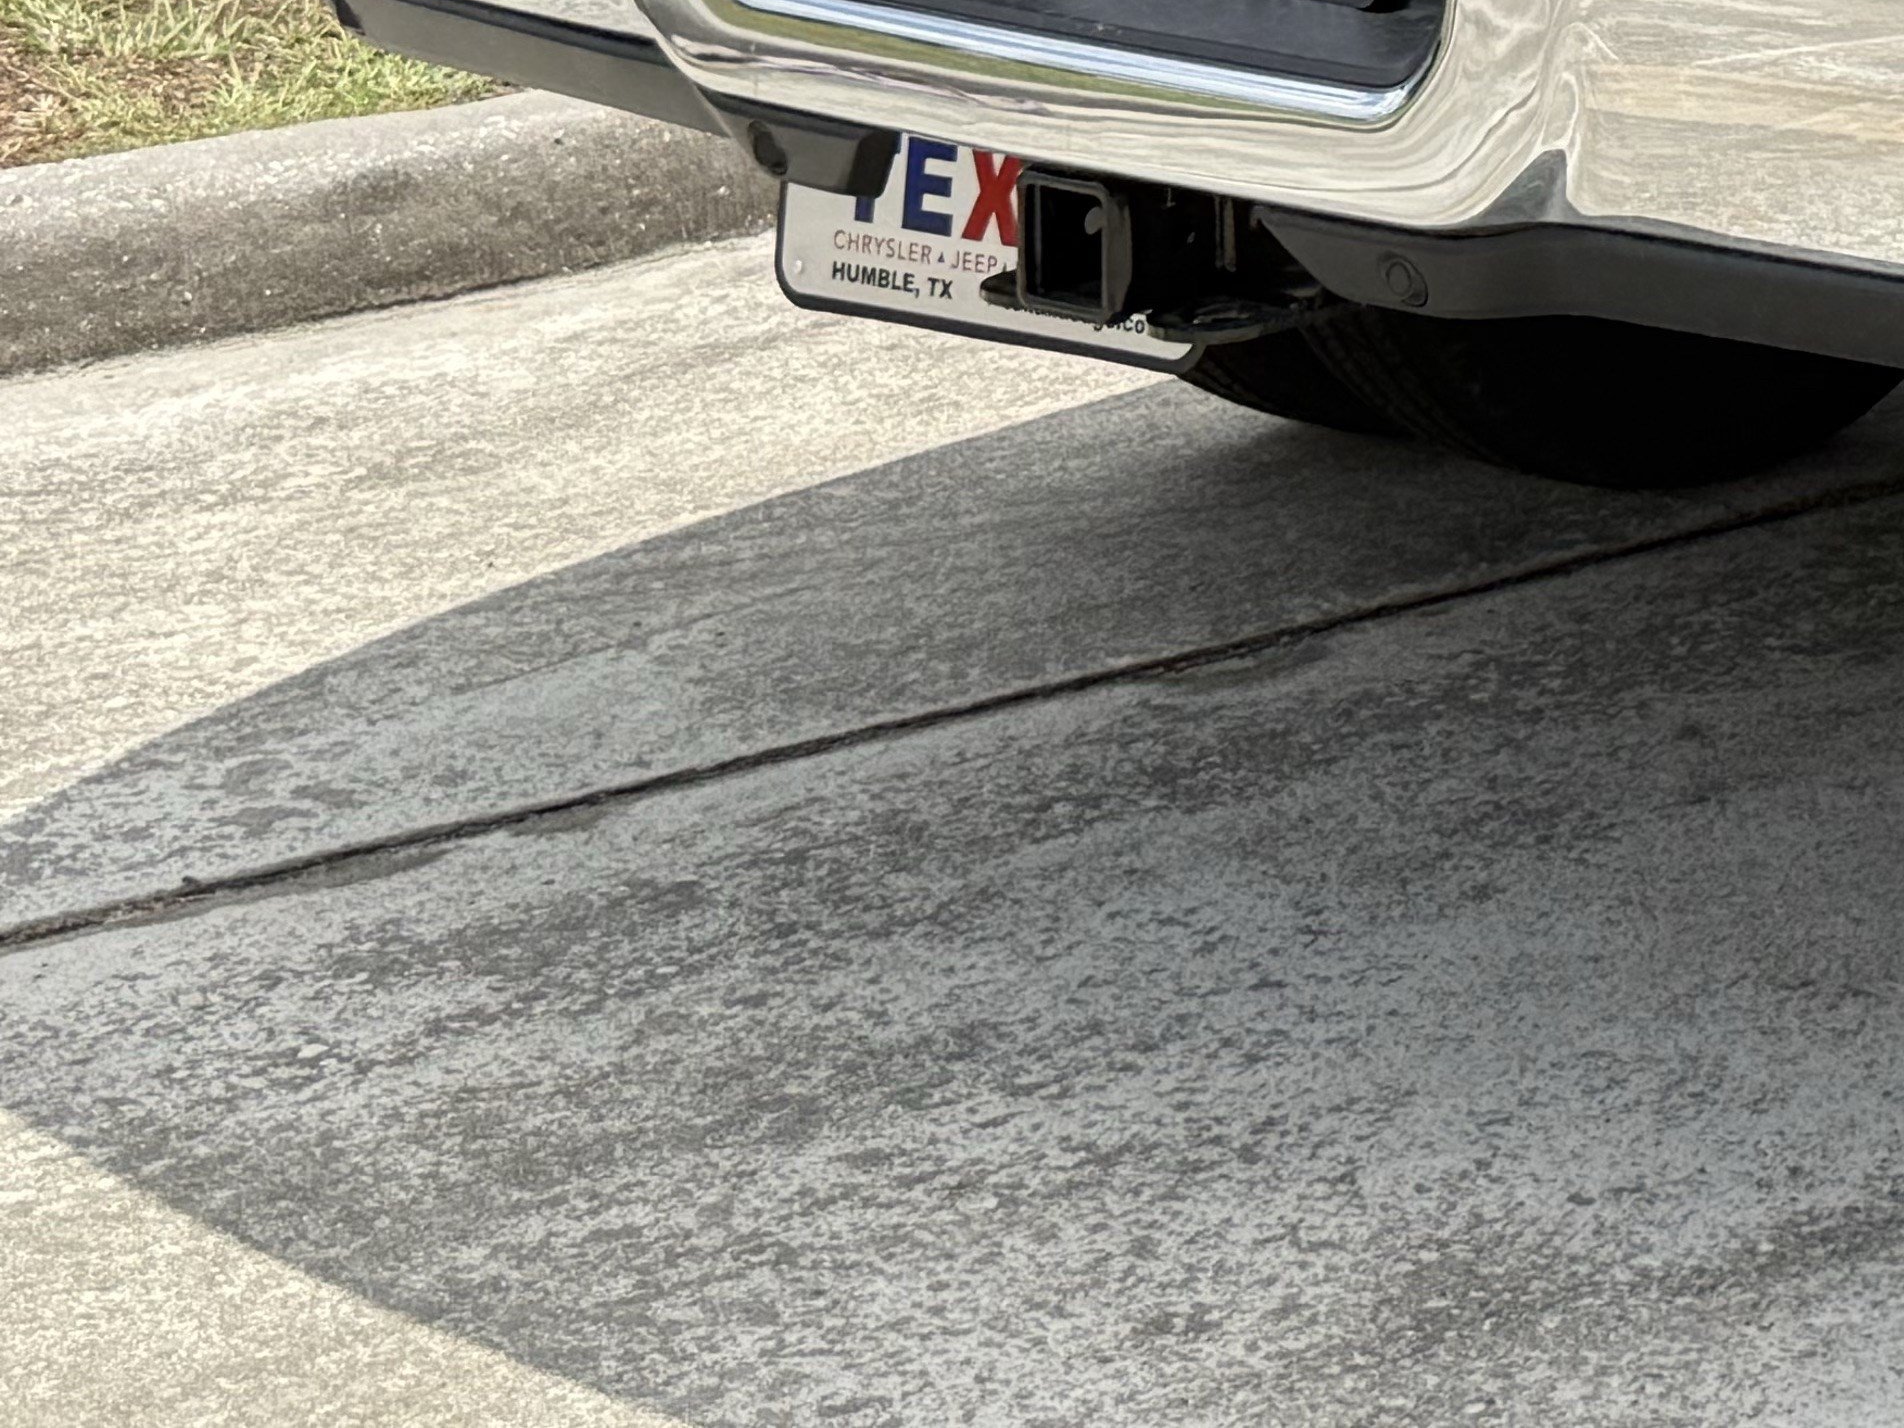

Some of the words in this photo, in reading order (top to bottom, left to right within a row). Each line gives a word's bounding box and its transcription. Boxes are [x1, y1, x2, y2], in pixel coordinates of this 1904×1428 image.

[834, 228, 932, 266] CHRYSLER
[950, 250, 998, 274] JEEP
[831, 261, 920, 299] HUMBLE,
[928, 277, 954, 300] TX
